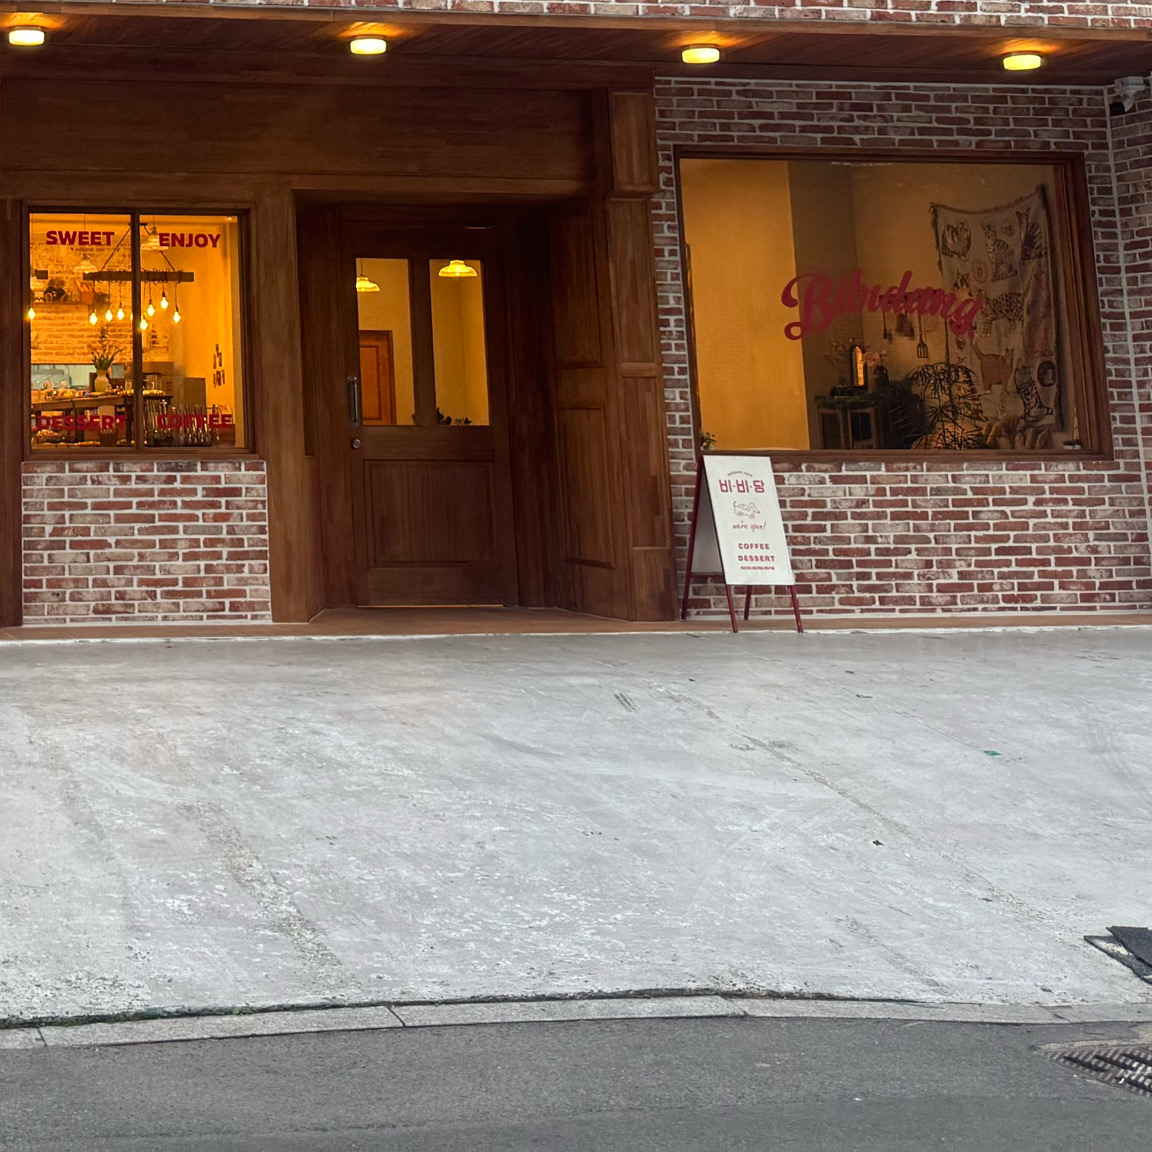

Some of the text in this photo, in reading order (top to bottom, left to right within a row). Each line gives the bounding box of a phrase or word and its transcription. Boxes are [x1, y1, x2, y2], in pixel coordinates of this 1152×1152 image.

[45, 230, 115, 247] SWEET
[158, 232, 222, 248] ENJOY
[780, 267, 985, 341] Bibidang
[37, 414, 128, 431] DESSERT
[157, 413, 234, 429] COFFEE
[738, 542, 770, 550] COFFEE
